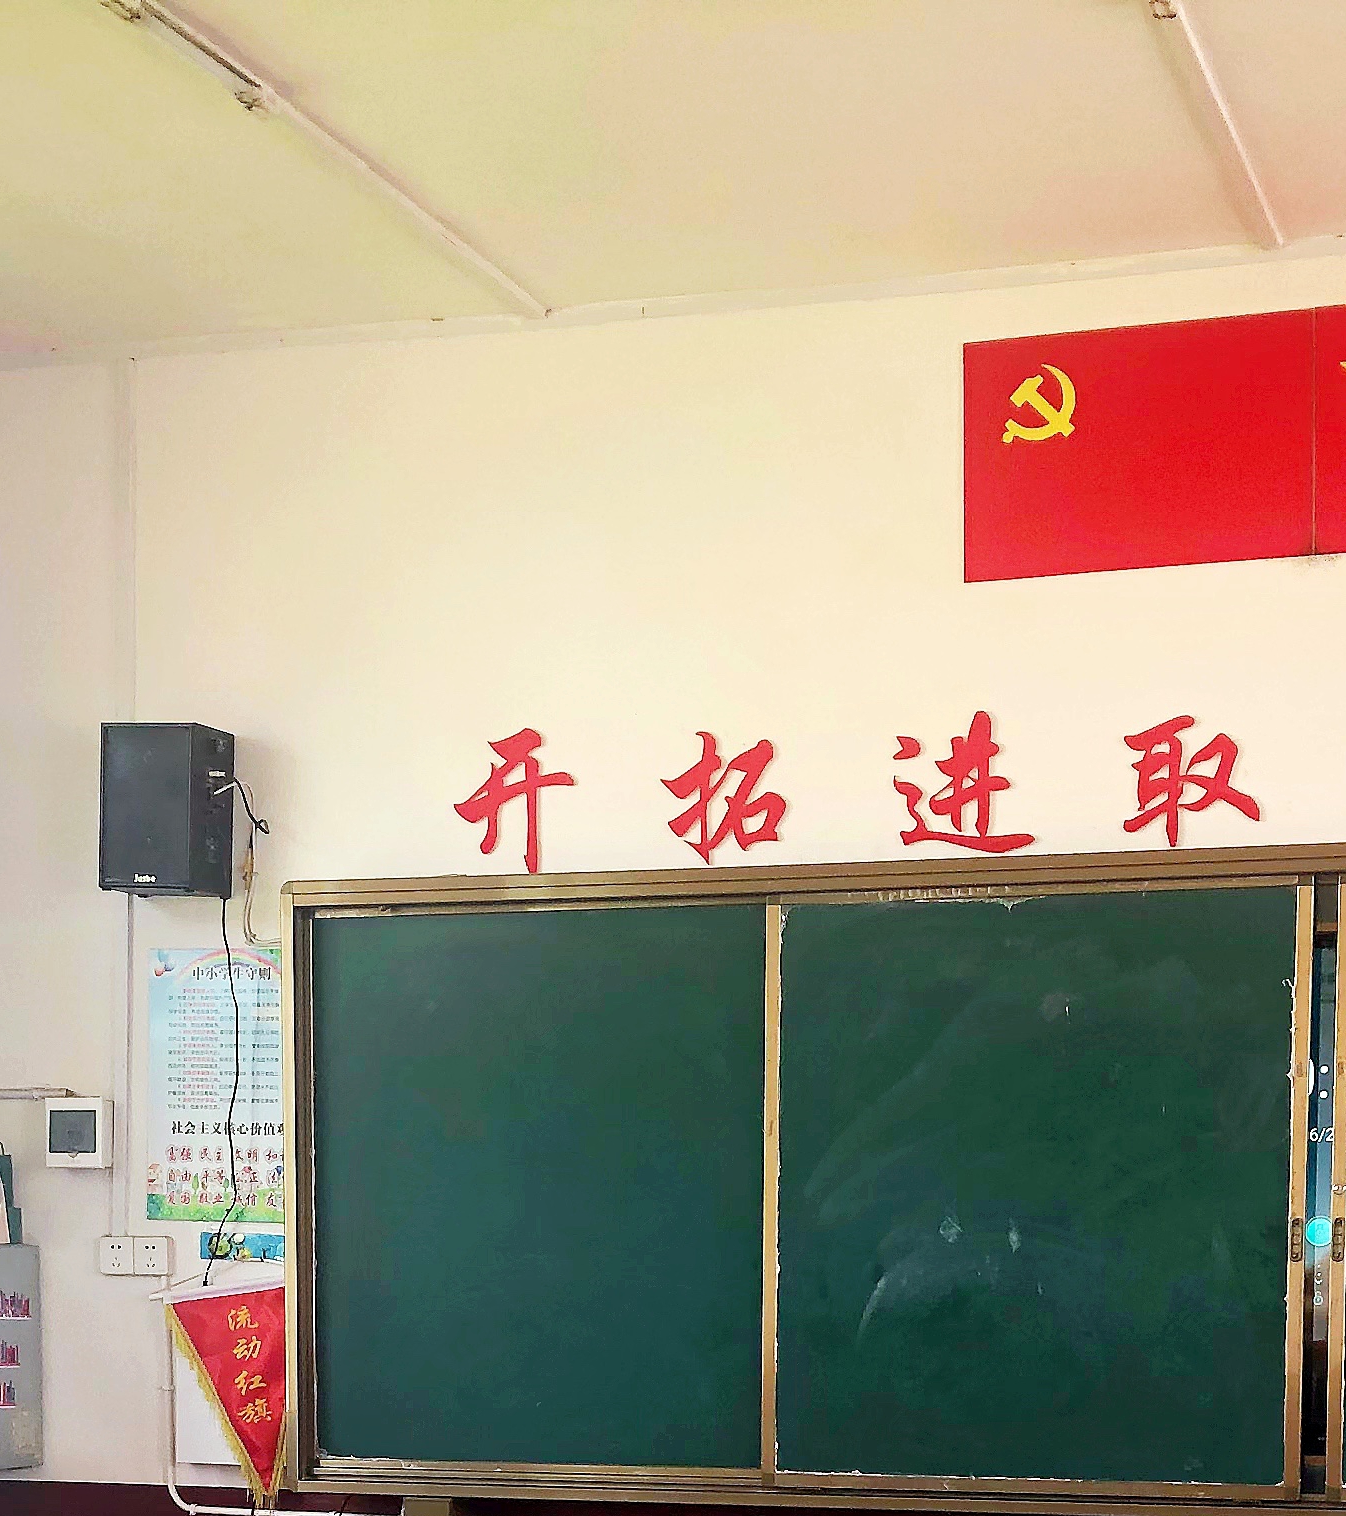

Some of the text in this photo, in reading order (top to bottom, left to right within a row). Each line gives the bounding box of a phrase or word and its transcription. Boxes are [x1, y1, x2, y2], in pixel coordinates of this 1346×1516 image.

[454, 711, 1260, 873] 开拓进取
[192, 966, 272, 981] 中小学生守则
[265, 1149, 284, 1162] 和
[227, 1306, 272, 1424] 流动红旗
